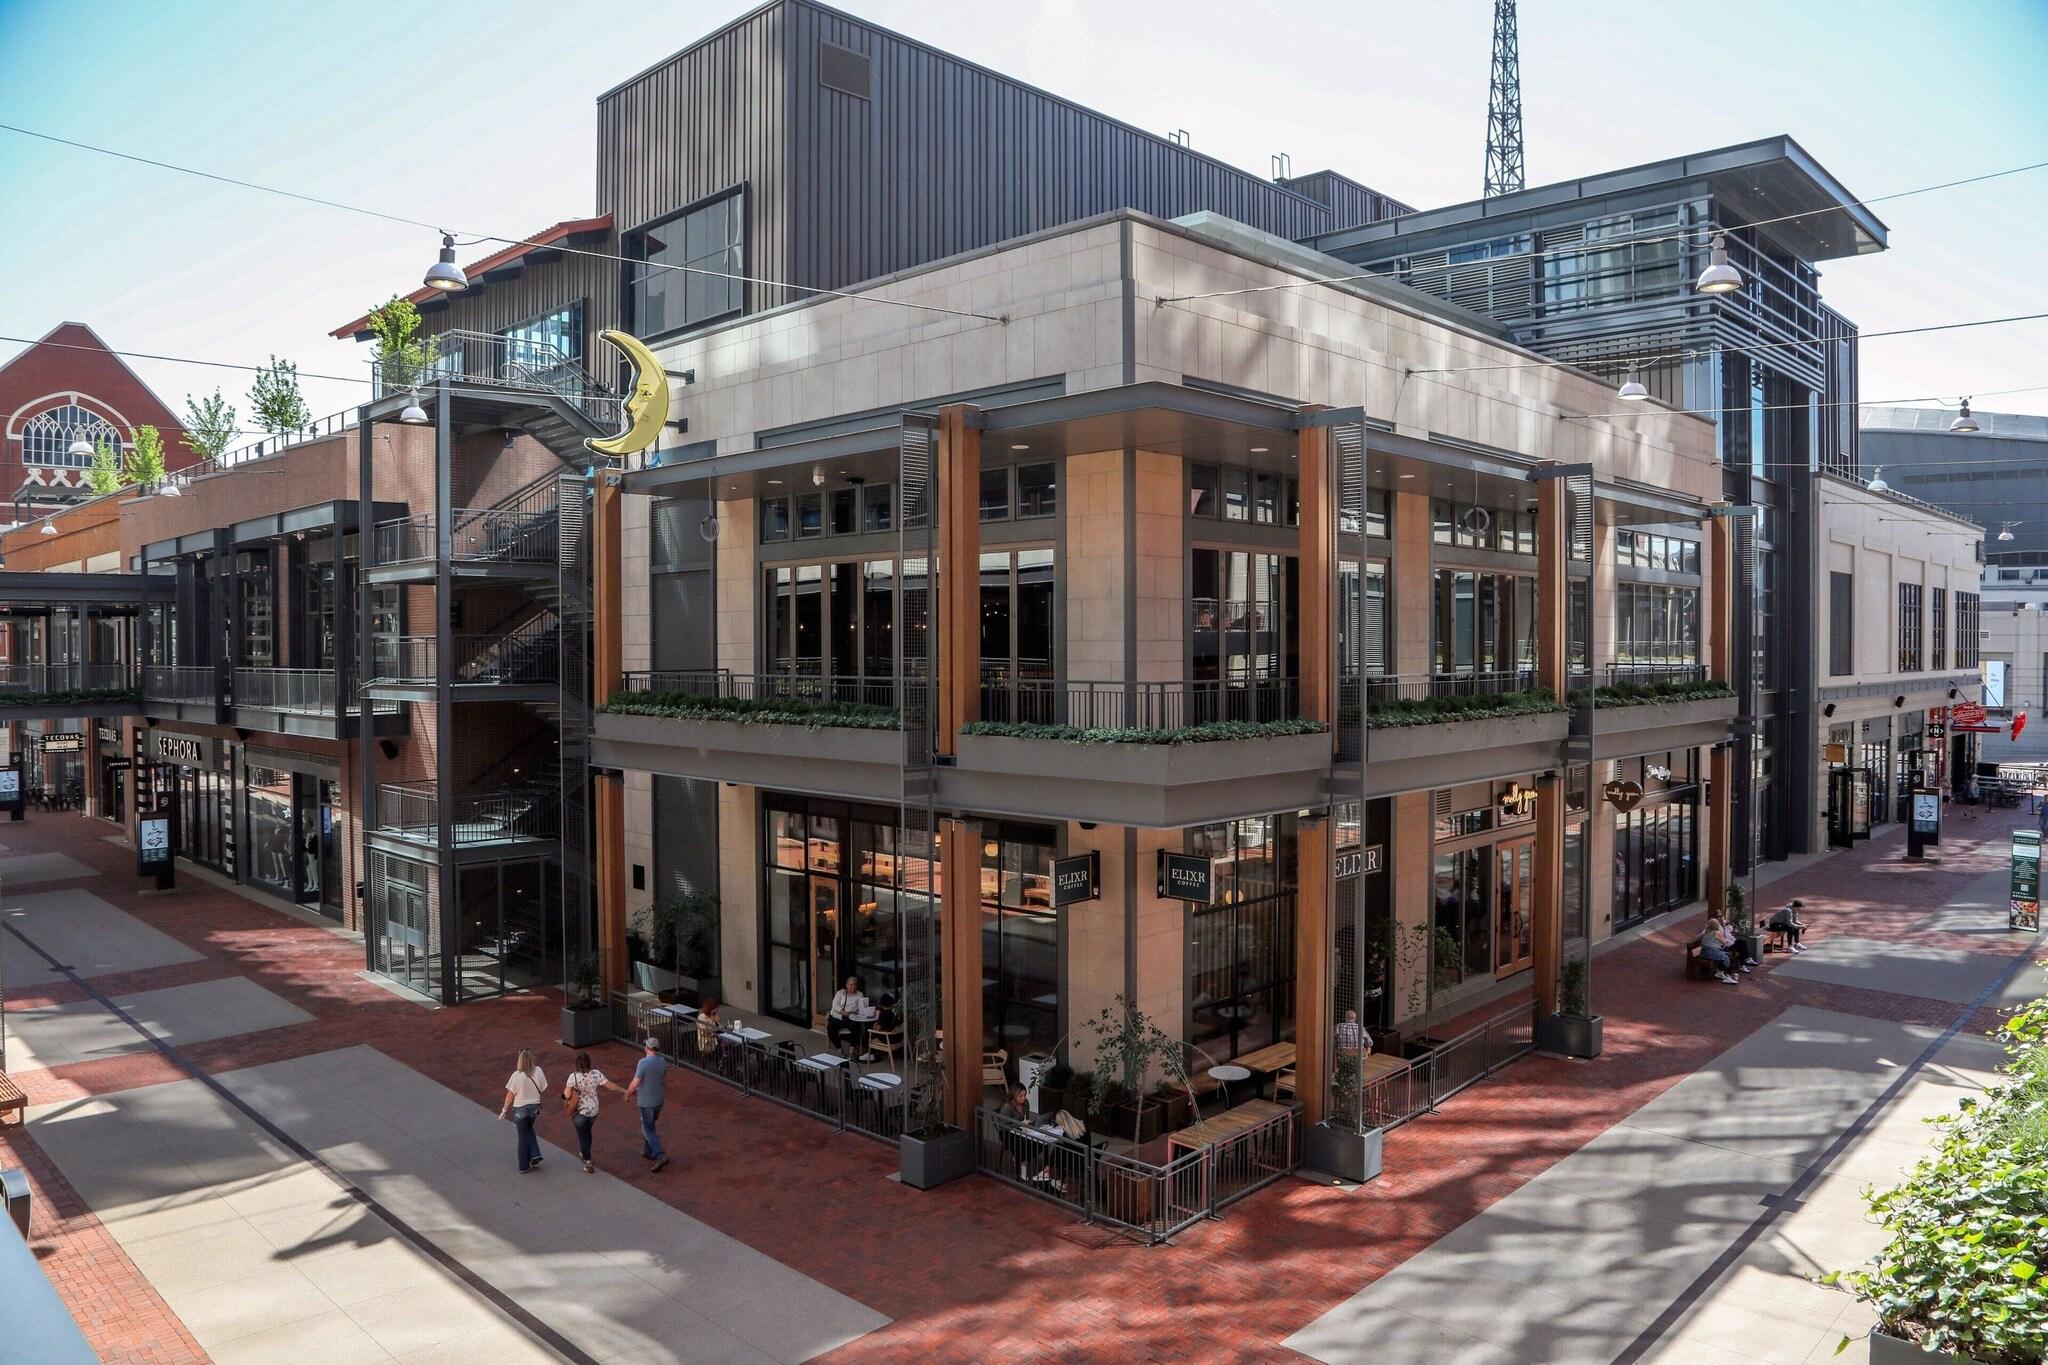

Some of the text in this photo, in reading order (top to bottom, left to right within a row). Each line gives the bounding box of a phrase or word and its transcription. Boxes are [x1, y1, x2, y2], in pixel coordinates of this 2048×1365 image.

[99, 728, 118, 741] TECOVAS
[159, 737, 198, 761] SEPHORA
[1058, 870, 1088, 886] ELIXR
[1171, 868, 1206, 883] ELIXR
[1063, 881, 1083, 890] COFFEE
[1177, 880, 1200, 888] COFFEE
